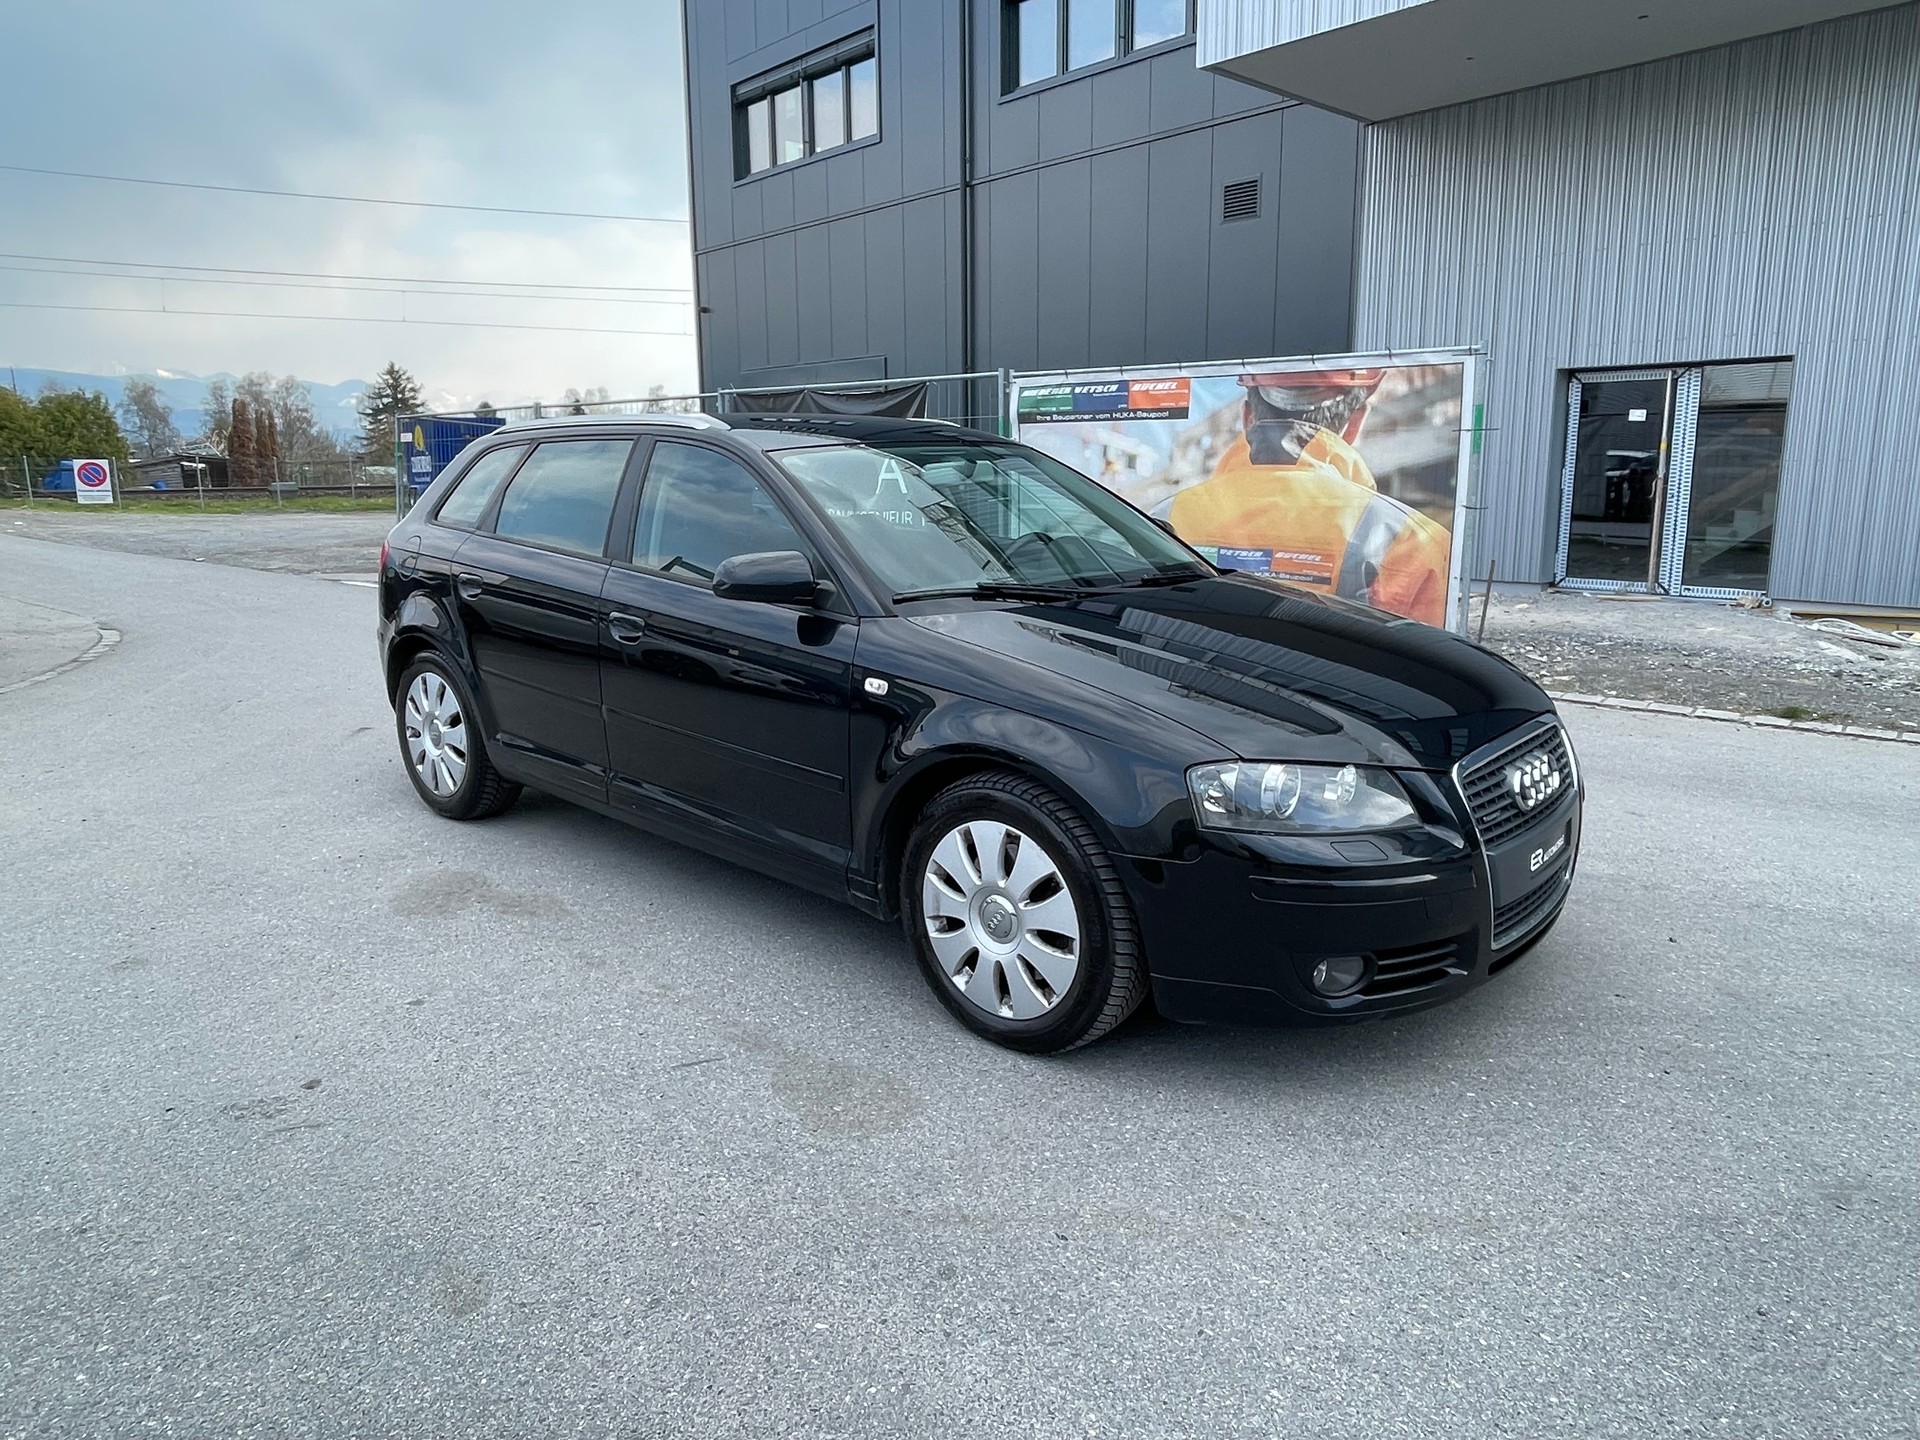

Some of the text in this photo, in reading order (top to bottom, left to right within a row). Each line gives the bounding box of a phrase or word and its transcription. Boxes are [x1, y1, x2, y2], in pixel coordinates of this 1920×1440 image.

[1073, 383, 1120, 394] VETSCH
[1052, 413, 1093, 422] Baupartner
[1095, 412, 1111, 420] vom
[1112, 410, 1170, 419] HUKA-Baupool
[875, 458, 909, 494] A
